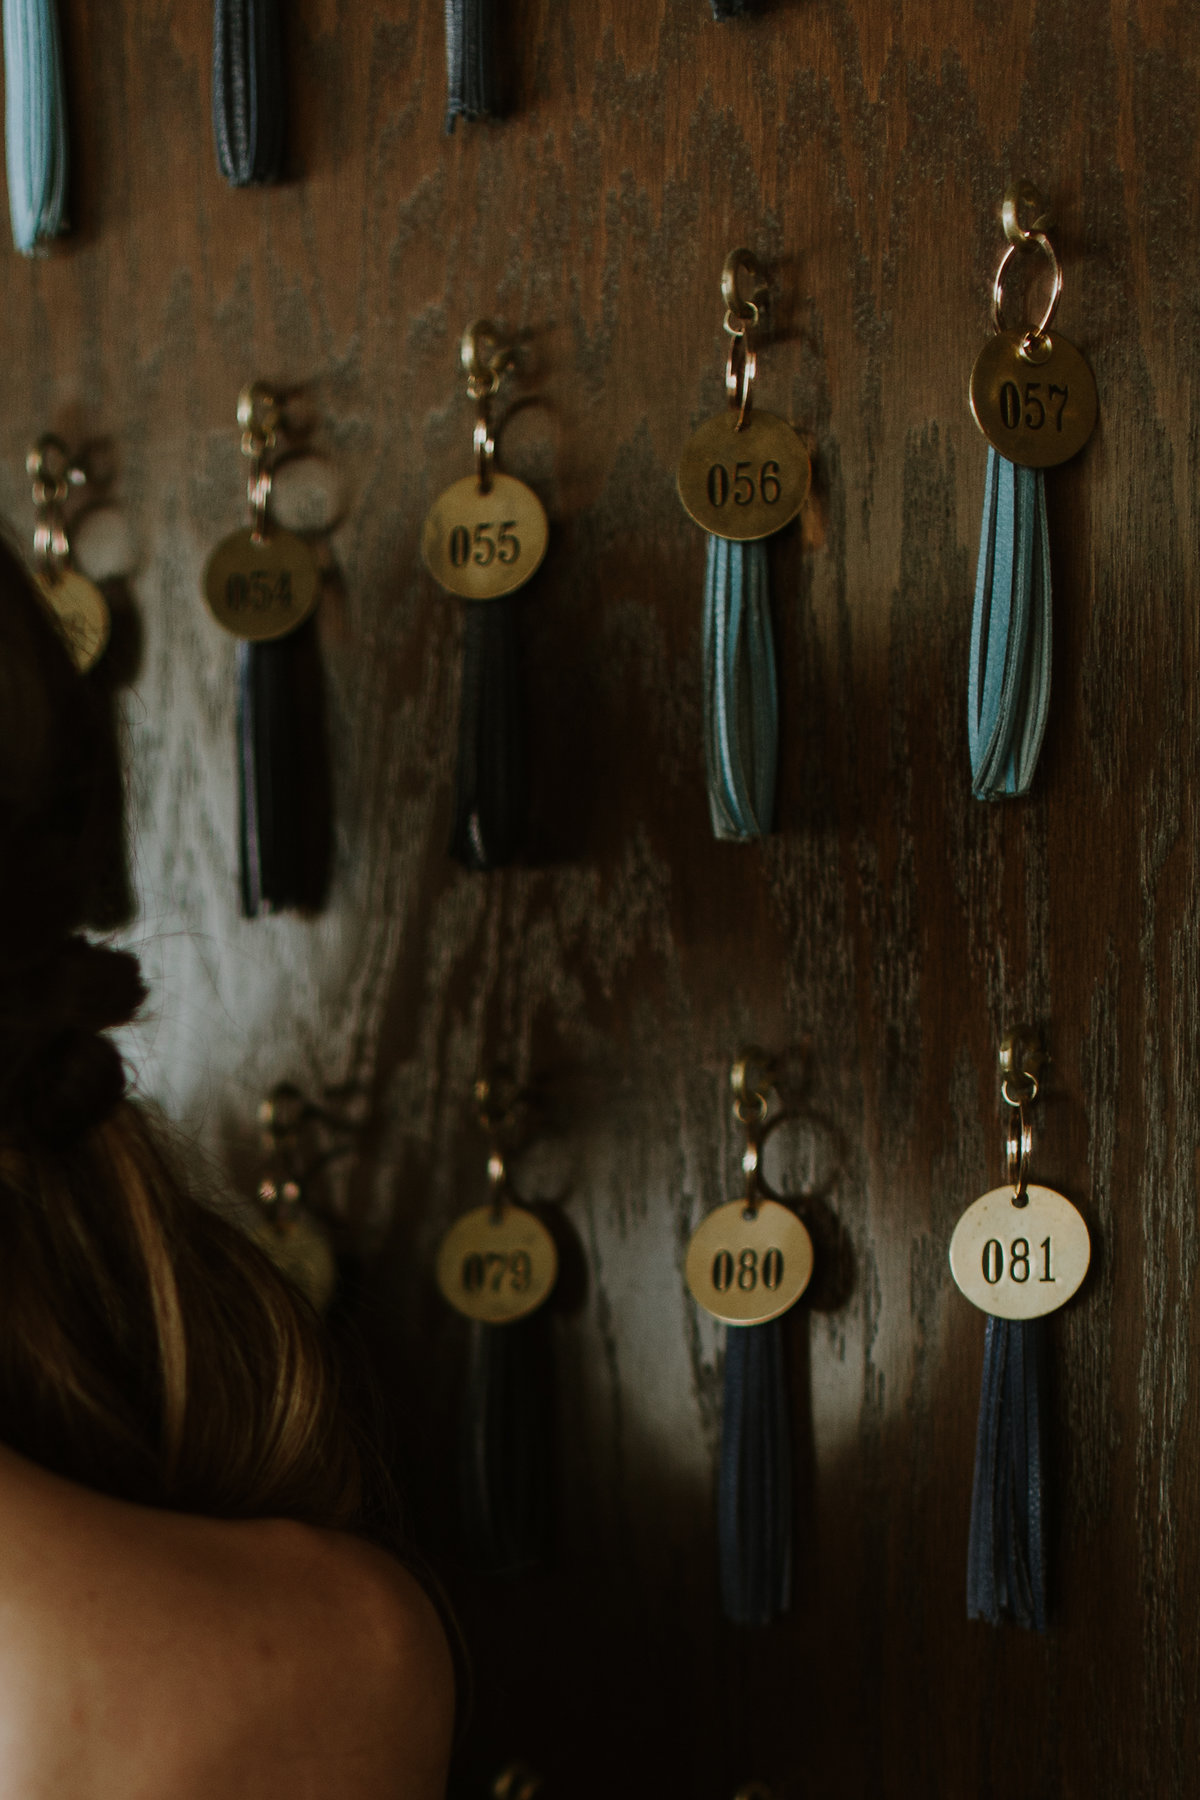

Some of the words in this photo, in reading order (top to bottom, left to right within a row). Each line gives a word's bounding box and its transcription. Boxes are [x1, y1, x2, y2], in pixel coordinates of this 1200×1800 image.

[999, 380, 1069, 433] 057
[707, 460, 781, 508] 056
[449, 521, 519, 568] 055
[225, 569, 294, 613] 054
[462, 1249, 533, 1293] 079
[712, 1248, 784, 1293] 080
[982, 1236, 1057, 1284] 081
